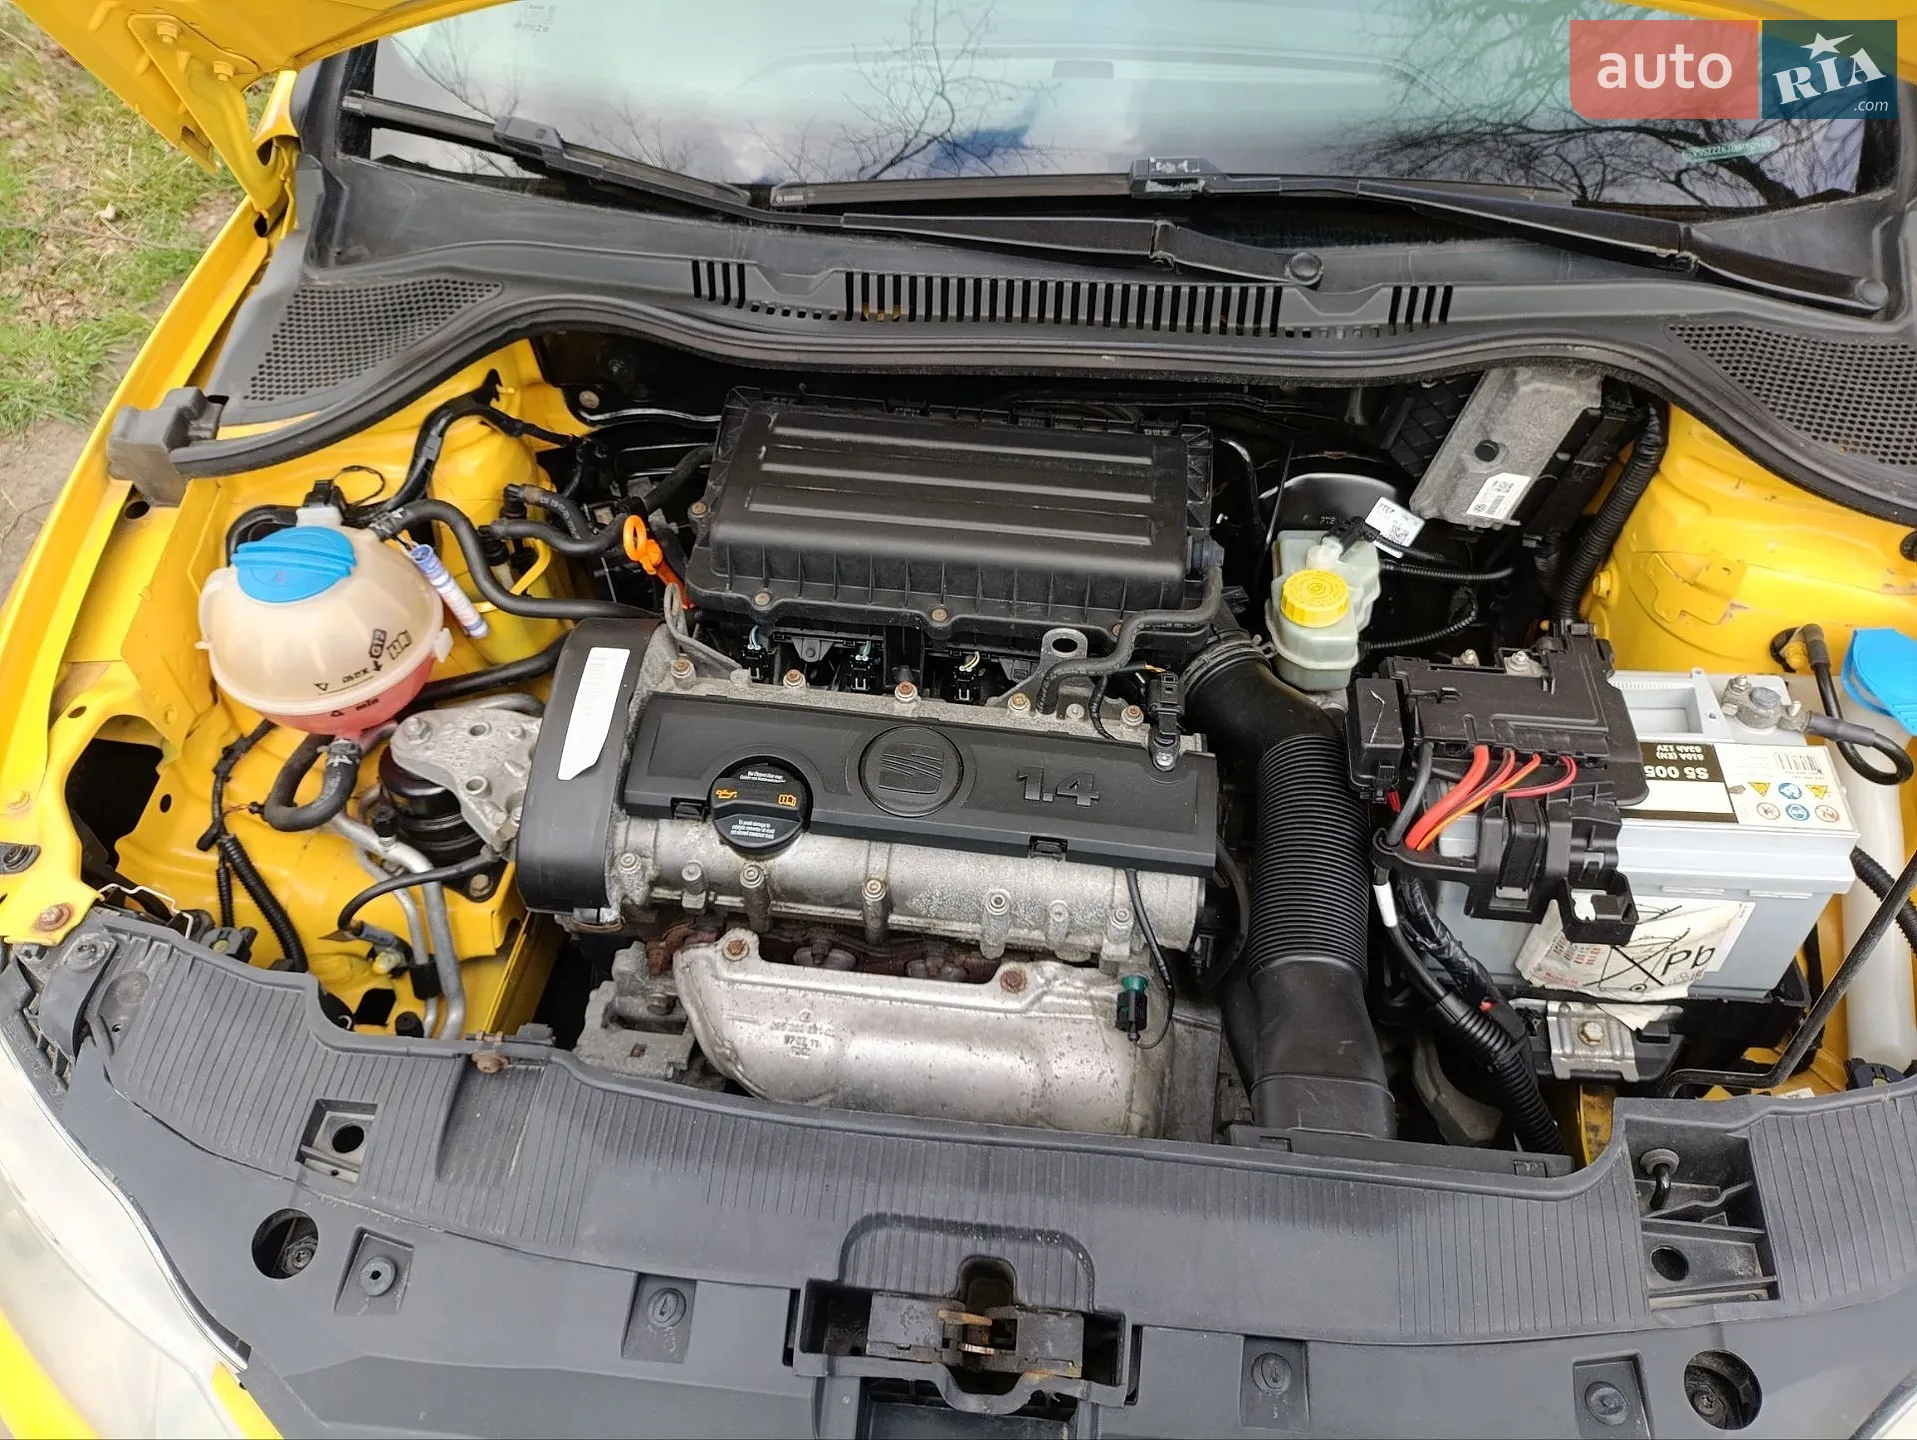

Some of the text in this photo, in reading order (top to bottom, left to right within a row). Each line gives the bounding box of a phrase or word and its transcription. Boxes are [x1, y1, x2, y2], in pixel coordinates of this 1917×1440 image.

[1656, 744, 1675, 752] 12V
[1643, 765, 1709, 780] S5 005
[1015, 766, 1101, 808] 1.4
[1662, 944, 1716, 977] Pb
